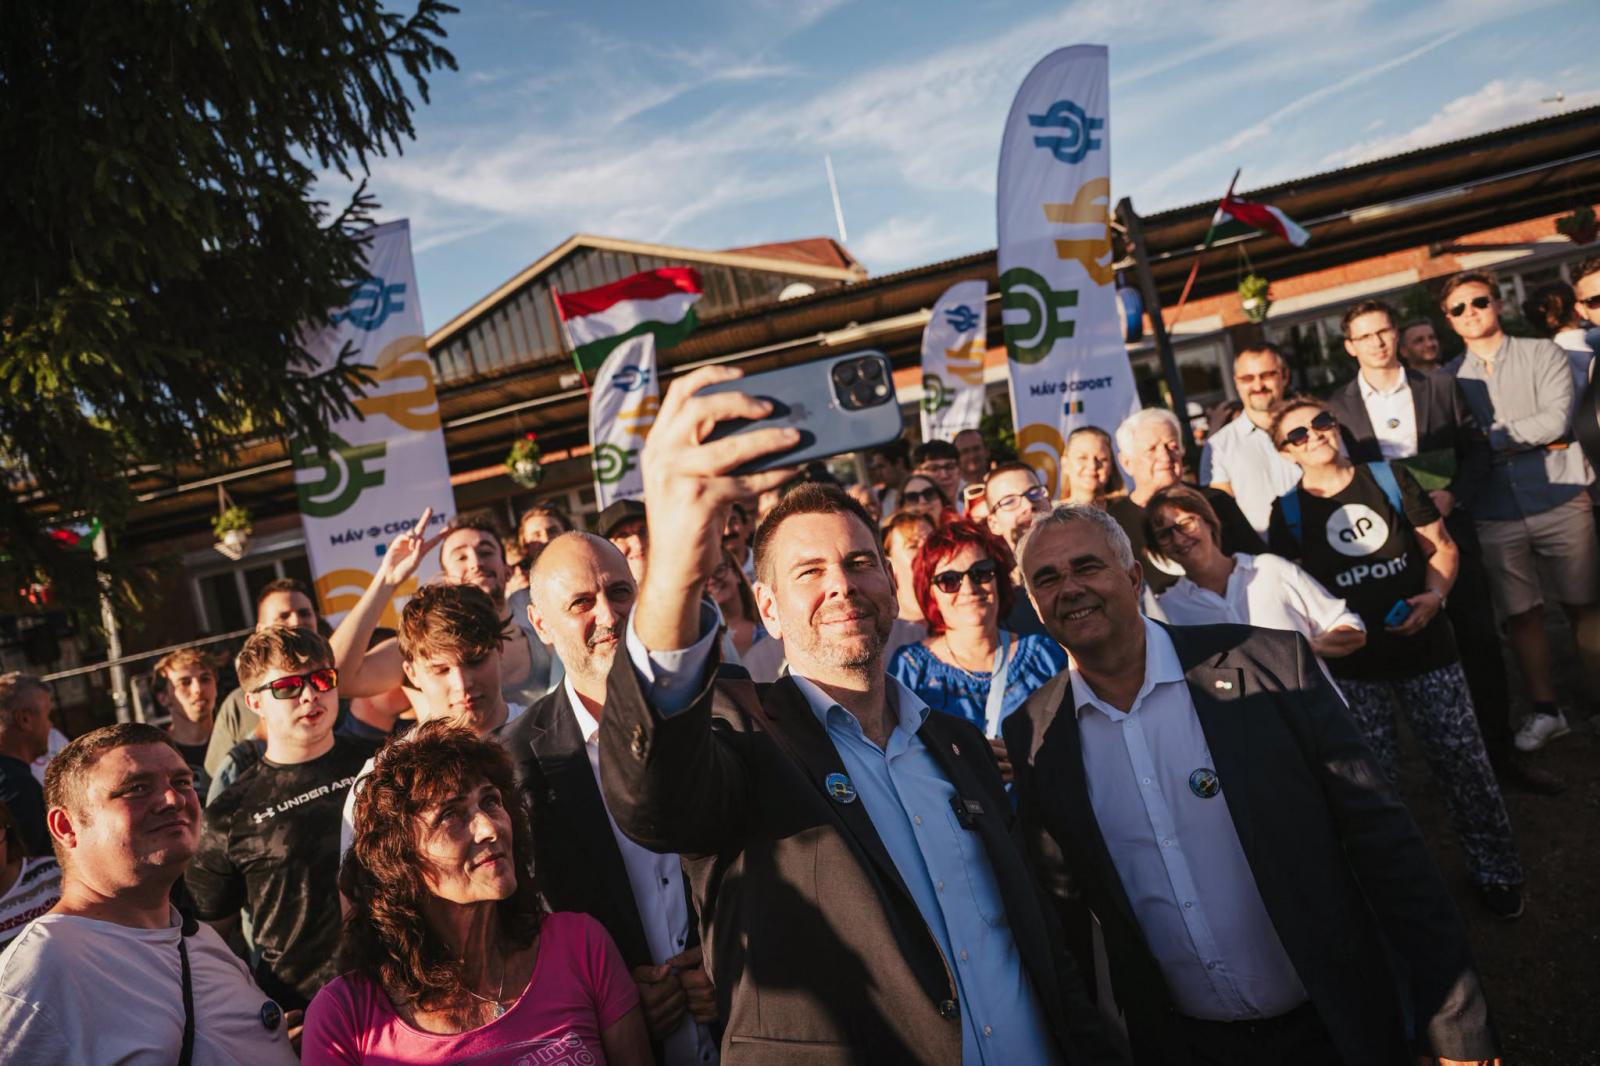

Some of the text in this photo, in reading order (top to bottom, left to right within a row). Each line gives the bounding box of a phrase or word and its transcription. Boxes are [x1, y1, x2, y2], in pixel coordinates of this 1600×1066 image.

[1030, 381, 1056, 397] MÁV
[330, 513, 446, 545] MÁV CSOPRT
[277, 785, 330, 812] UNDER
